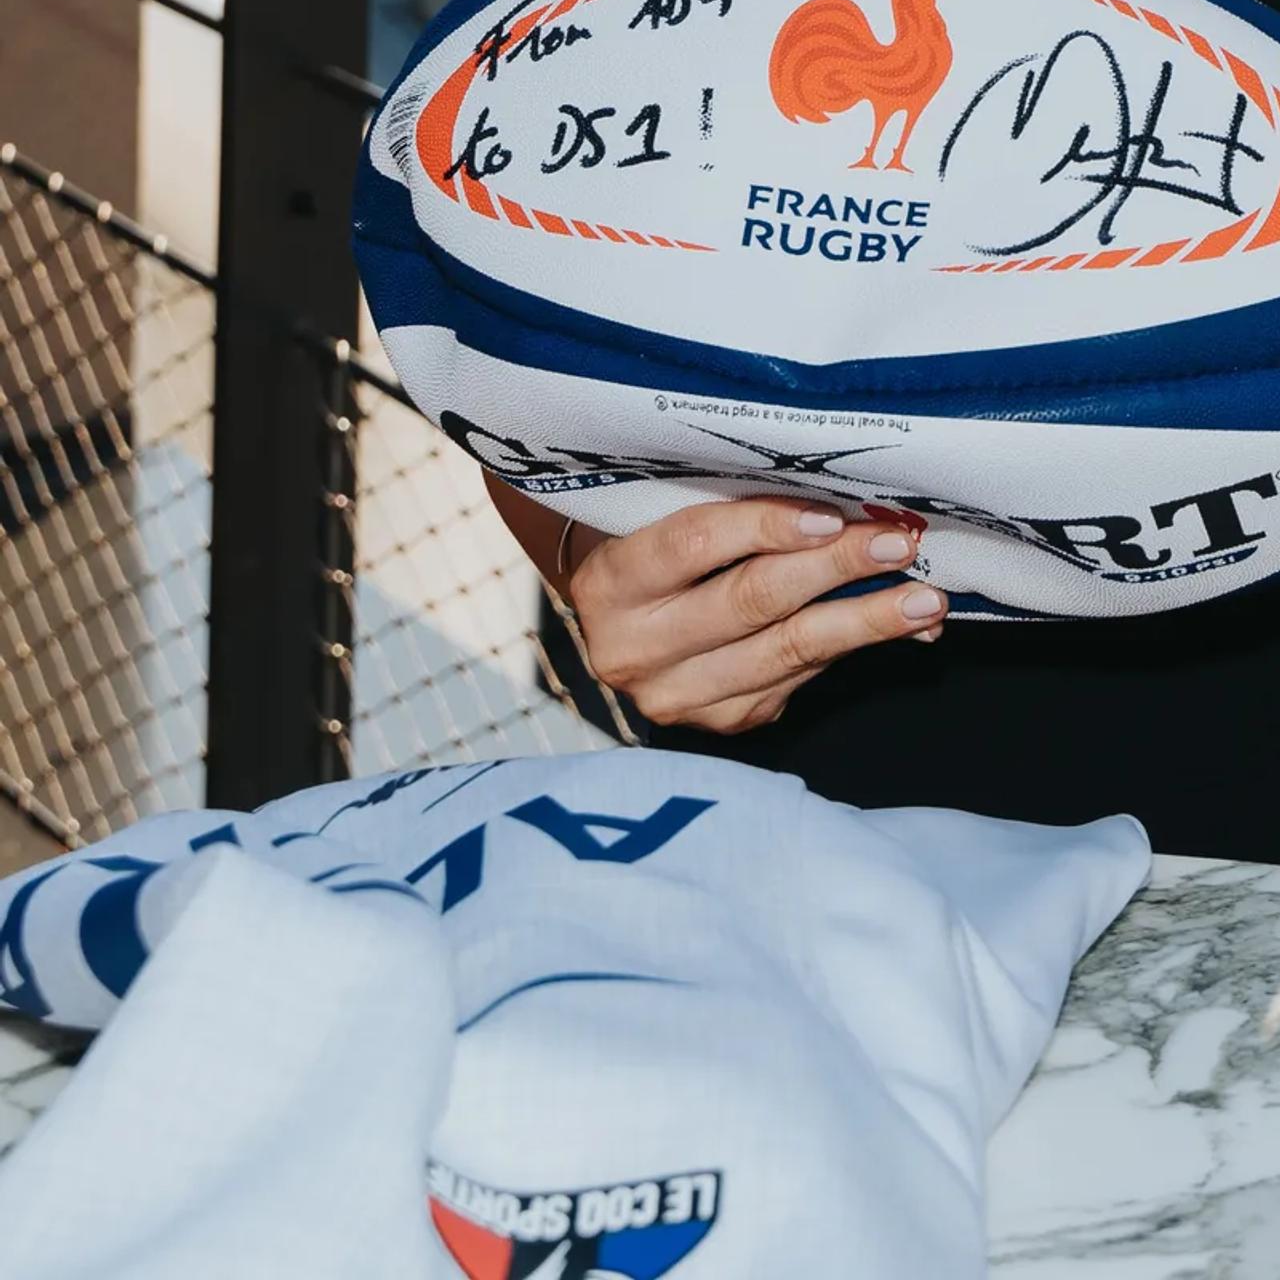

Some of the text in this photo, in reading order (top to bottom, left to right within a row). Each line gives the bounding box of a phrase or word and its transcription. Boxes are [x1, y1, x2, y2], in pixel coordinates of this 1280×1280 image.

[443, 107, 512, 181] to
[747, 184, 931, 227] FRANCE
[741, 218, 923, 263] RUGBY
[672, 400, 729, 418] trademark
[763, 411, 770, 420] a
[774, 411, 784, 423] is
[787, 412, 827, 426] device
[831, 415, 855, 427] trim
[858, 418, 885, 429] oval
[889, 420, 912, 433] The
[661, 1172, 718, 1224] LE
[574, 1182, 660, 1238] COQ
